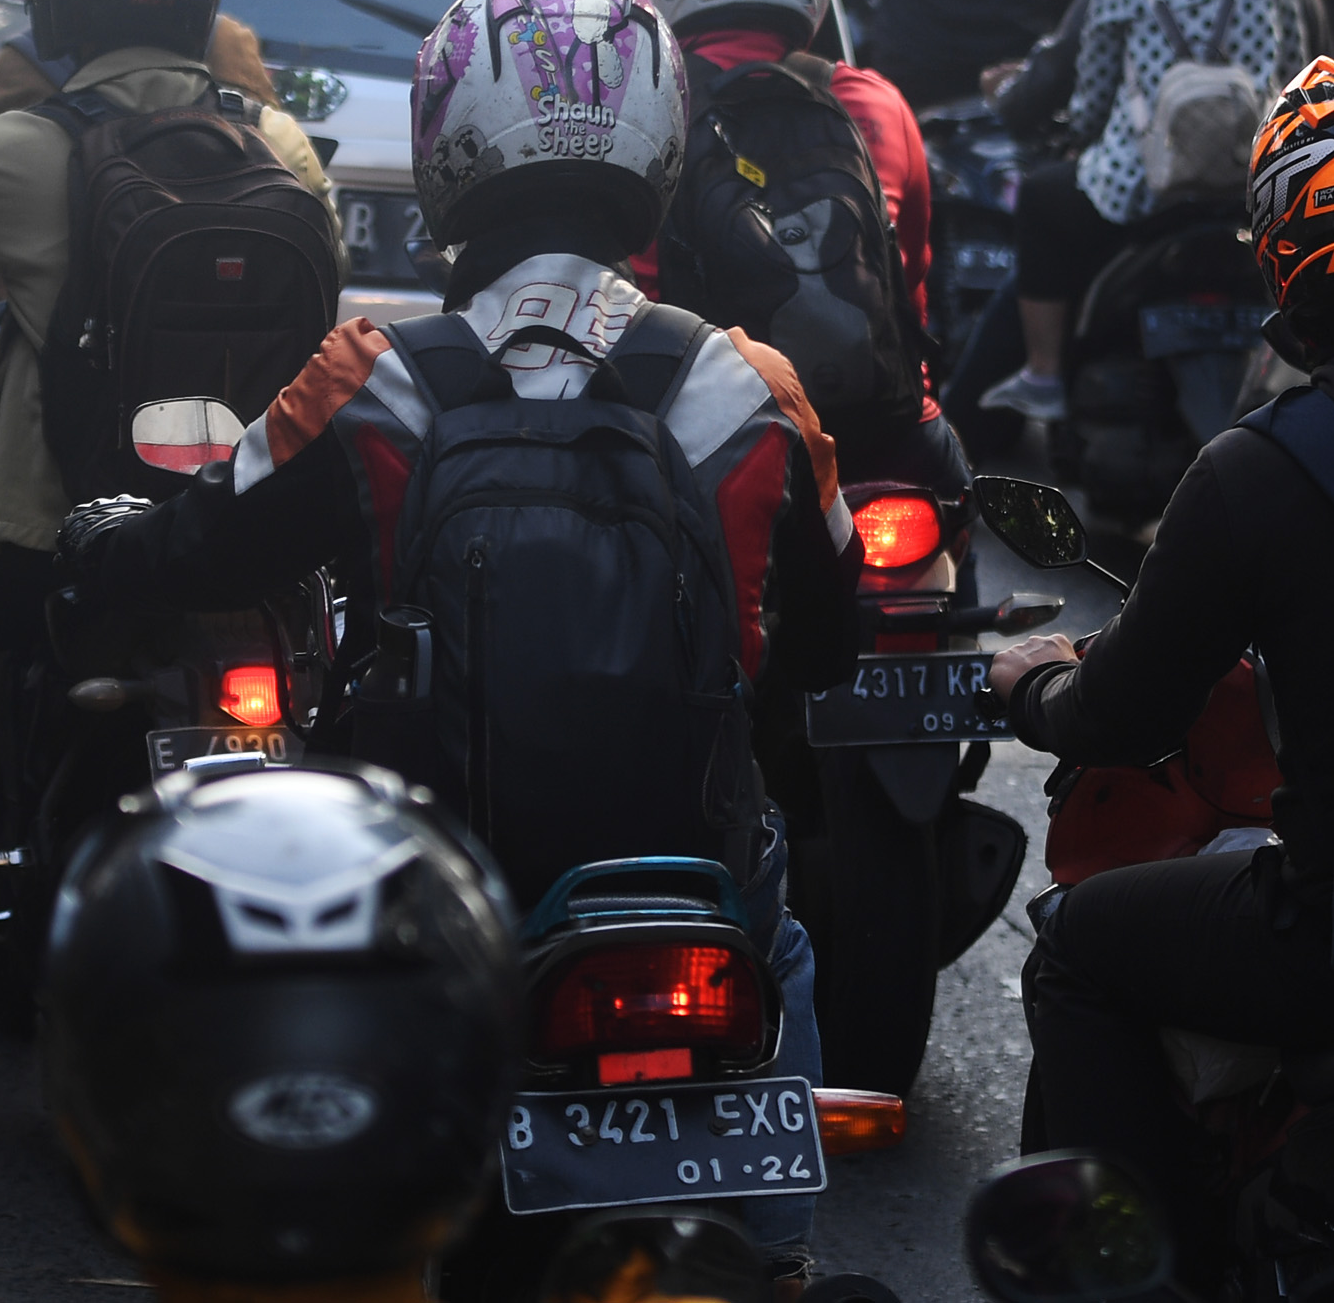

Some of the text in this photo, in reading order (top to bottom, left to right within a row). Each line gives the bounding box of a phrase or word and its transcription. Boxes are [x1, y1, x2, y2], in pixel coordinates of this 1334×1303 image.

[537, 94, 616, 127] Shaun
[565, 121, 586, 134] the
[538, 126, 613, 161] Sheep
[344, 201, 378, 252] B
[852, 664, 928, 700] 4317
[154, 737, 176, 770] E
[508, 1090, 805, 1150] B 3421 EXG
